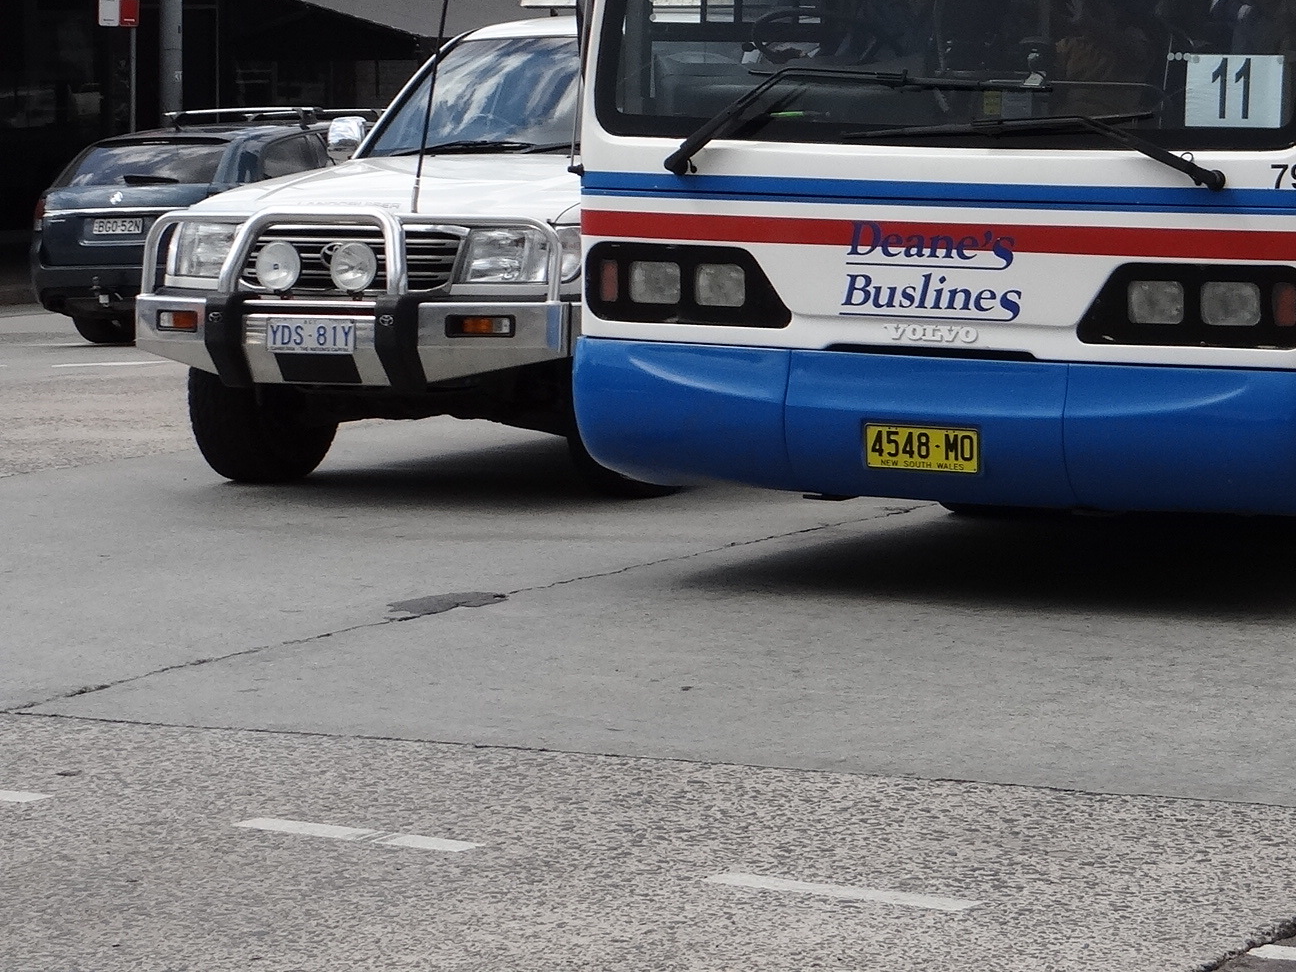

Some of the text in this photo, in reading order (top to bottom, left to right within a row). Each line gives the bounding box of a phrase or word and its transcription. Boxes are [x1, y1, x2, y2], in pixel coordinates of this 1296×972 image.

[1211, 57, 1251, 119] 11
[846, 220, 1016, 270] Deane's
[841, 272, 1022, 322] Buslines
[884, 323, 979, 343] VOLVO
[903, 460, 931, 468] SOUTH
[937, 462, 964, 471] WALES
